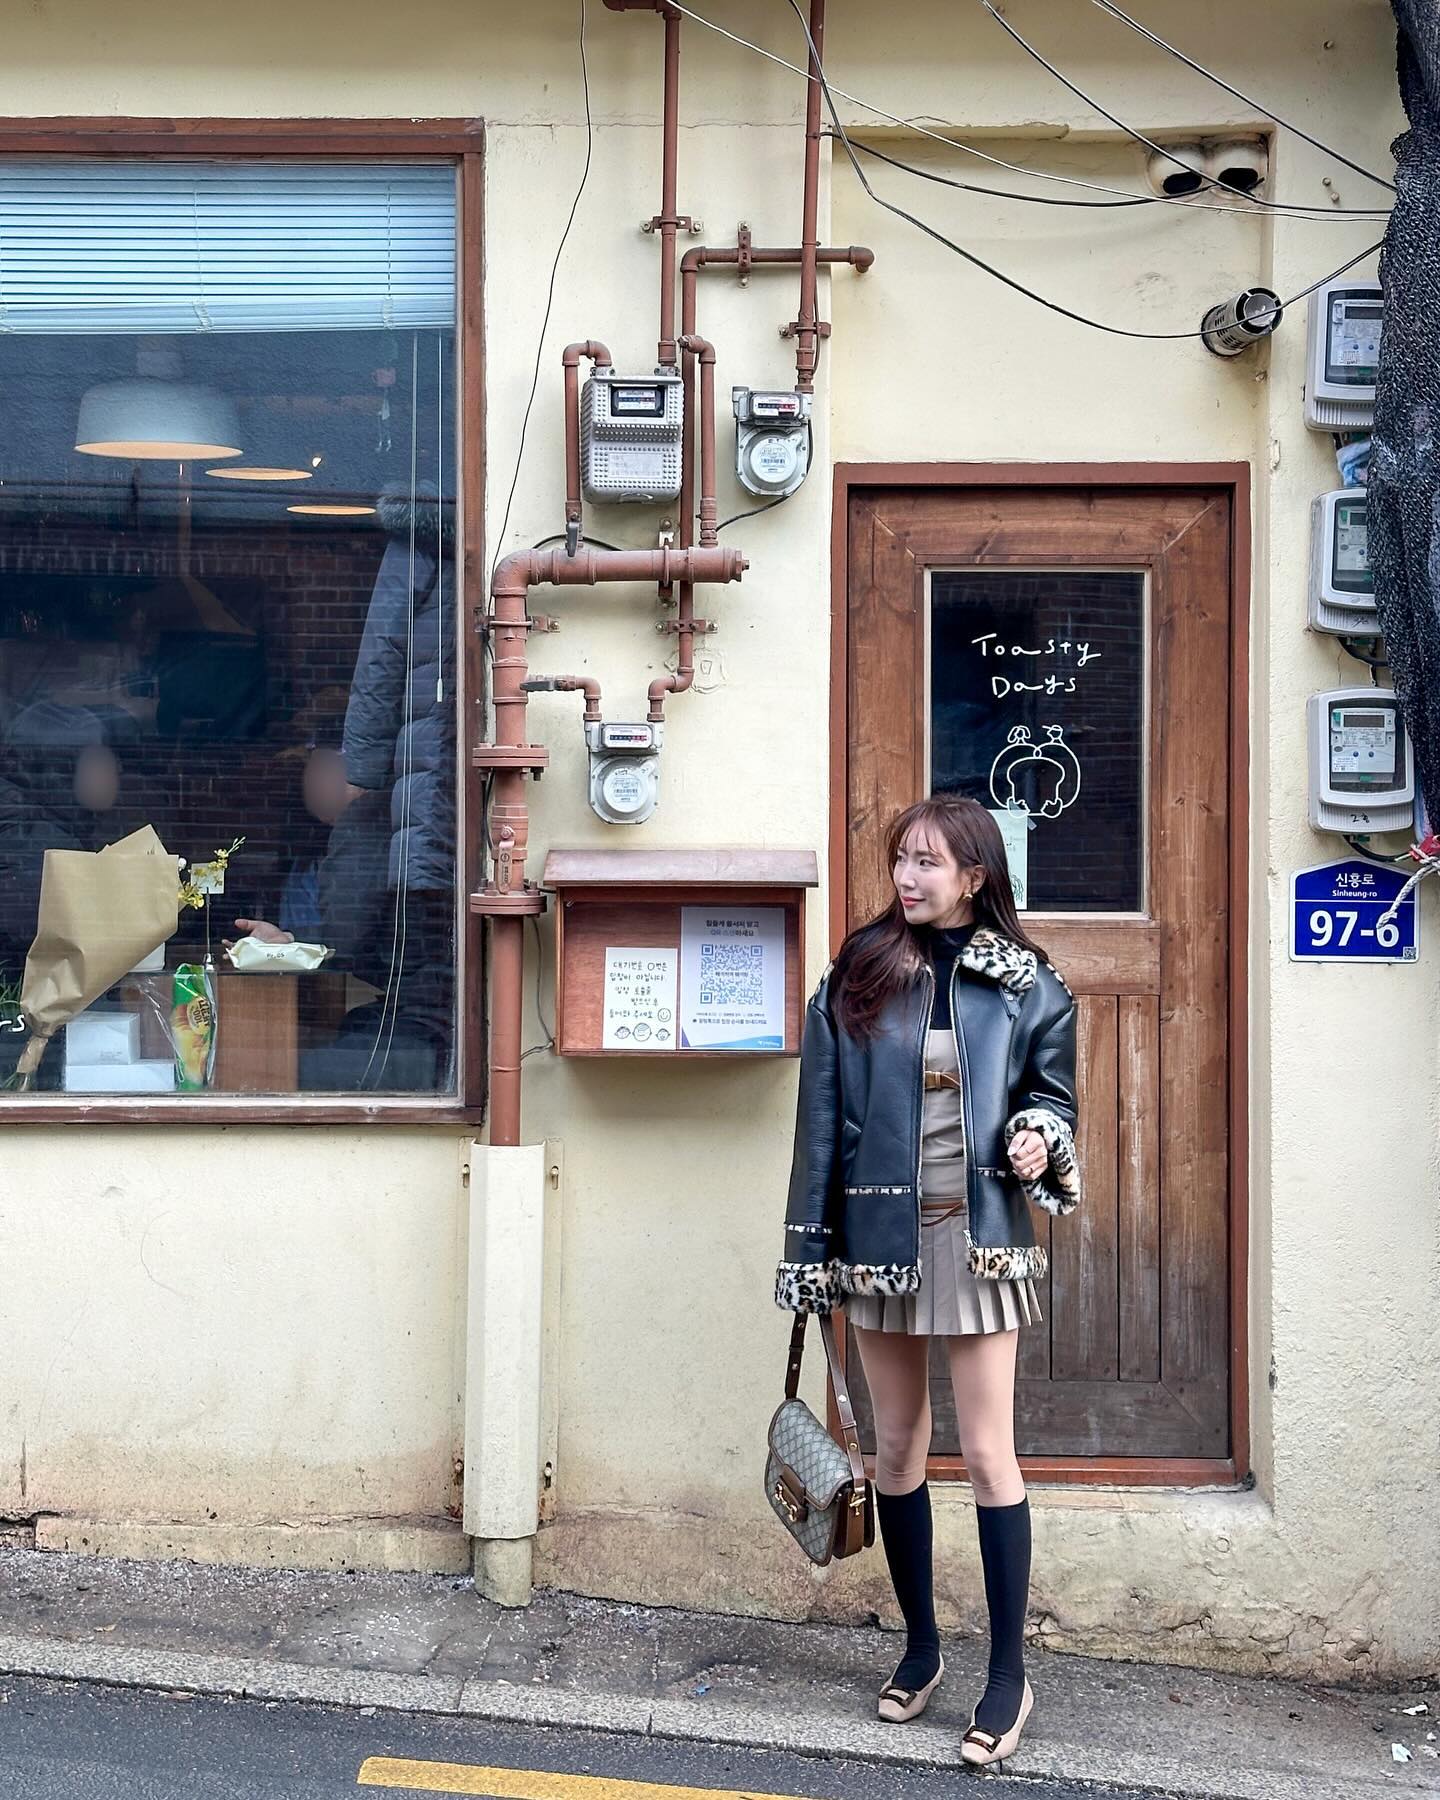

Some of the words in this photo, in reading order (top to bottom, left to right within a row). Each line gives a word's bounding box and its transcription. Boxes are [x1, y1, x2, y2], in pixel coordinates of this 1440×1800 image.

[972, 633, 1102, 667] Toasty
[992, 675, 1077, 699] Days
[1335, 873, 1375, 888] 신흥로
[1332, 890, 1378, 899] Sinheung-ro
[1309, 910, 1399, 948] 97-6
[636, 973, 664, 982] 아닙니다
